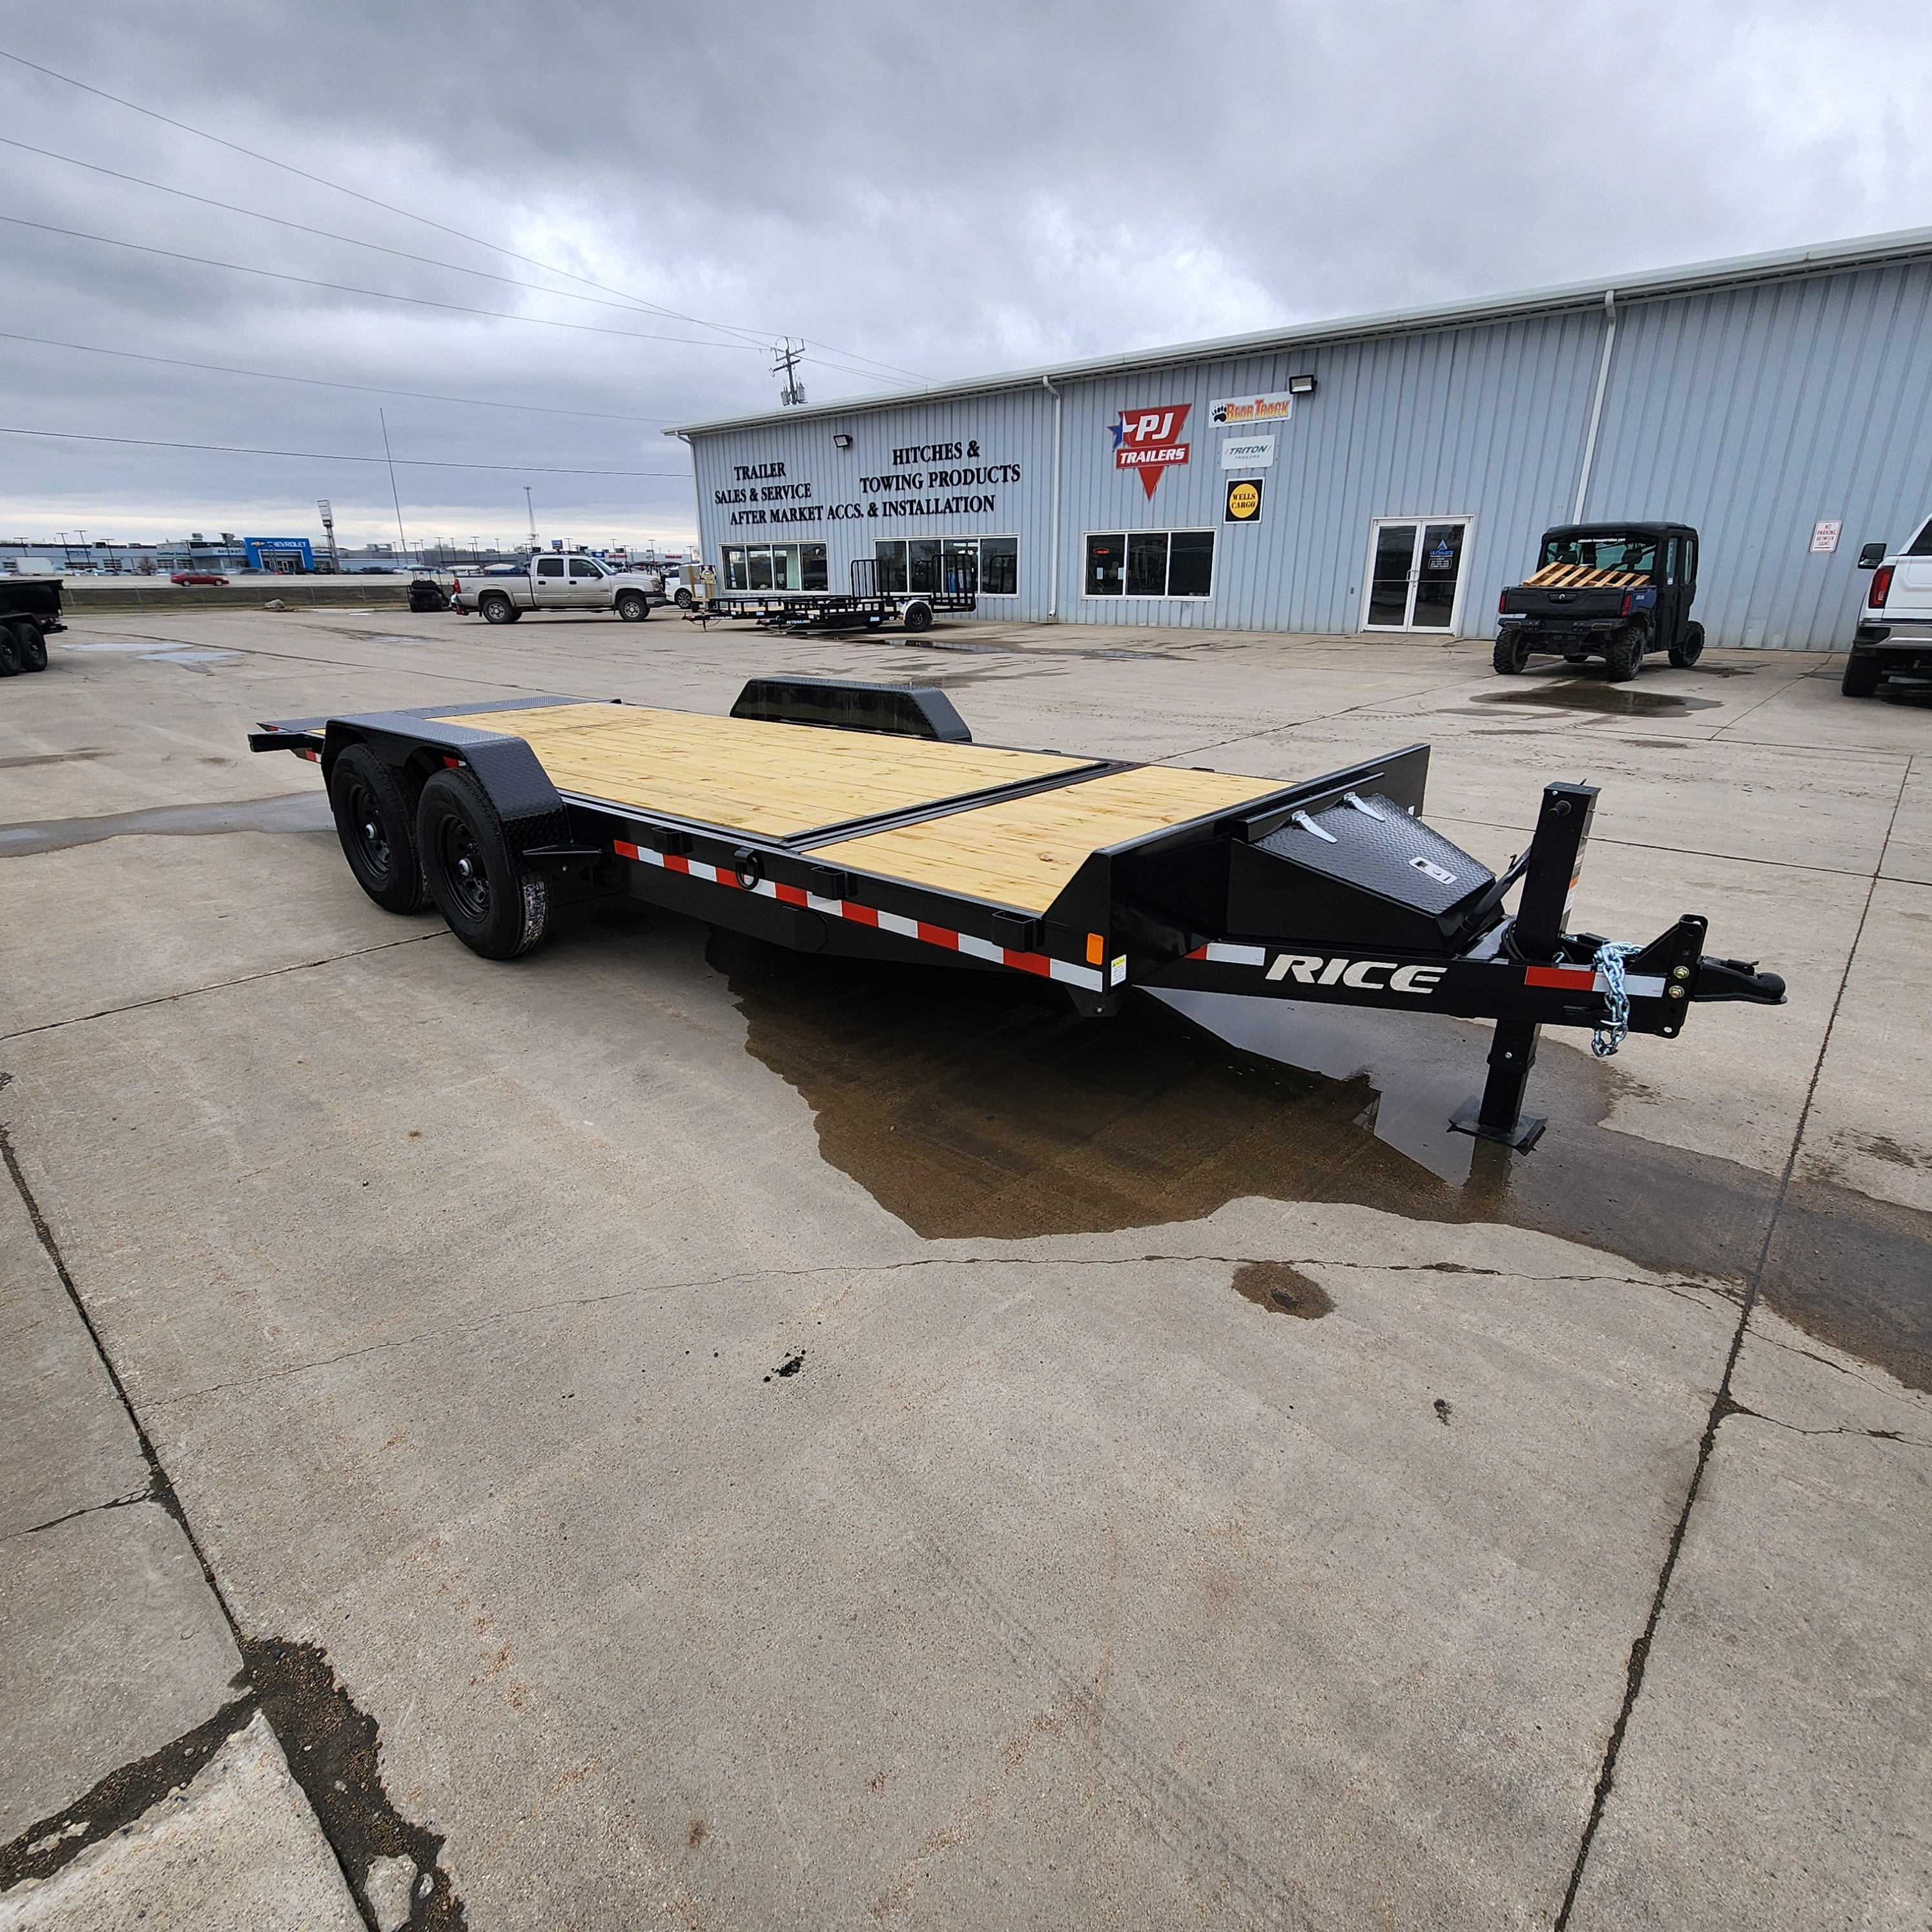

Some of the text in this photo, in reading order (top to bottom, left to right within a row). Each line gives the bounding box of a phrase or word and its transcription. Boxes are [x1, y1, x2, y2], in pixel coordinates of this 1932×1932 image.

[1226, 398, 1290, 422] BEAR TRACK
[1135, 412, 1175, 442] PJ
[892, 440, 980, 466] HITCHES &
[1120, 447, 1186, 464] TRAILERS
[1229, 445, 1268, 455] TRITON
[734, 462, 786, 480] TRAILER
[859, 464, 1021, 493] TOWING PRODUCTS
[715, 483, 812, 504] SALES & SERVICE
[730, 495, 996, 525] AFTER MARKET ACCS. & INSTALLATION
[1265, 954, 1448, 994] RICE
